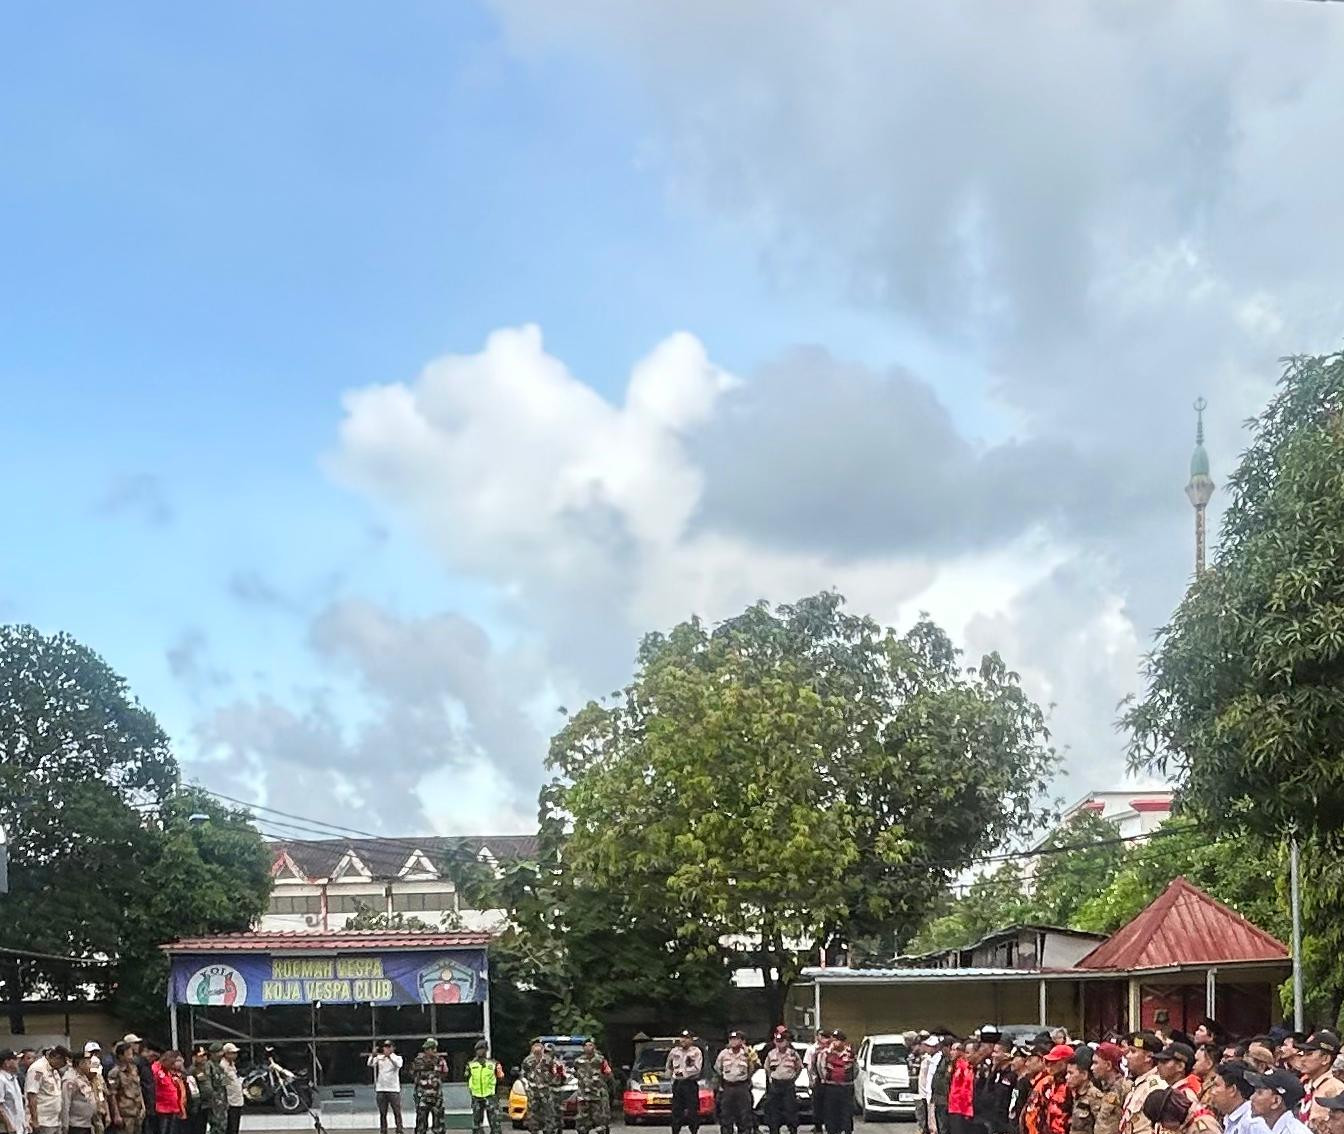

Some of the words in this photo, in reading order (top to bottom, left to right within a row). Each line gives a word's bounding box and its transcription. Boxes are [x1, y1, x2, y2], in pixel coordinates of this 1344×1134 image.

[262, 980, 303, 1001] KOJA
[304, 980, 351, 1001] VESPA
[353, 979, 392, 1000] CLUB
